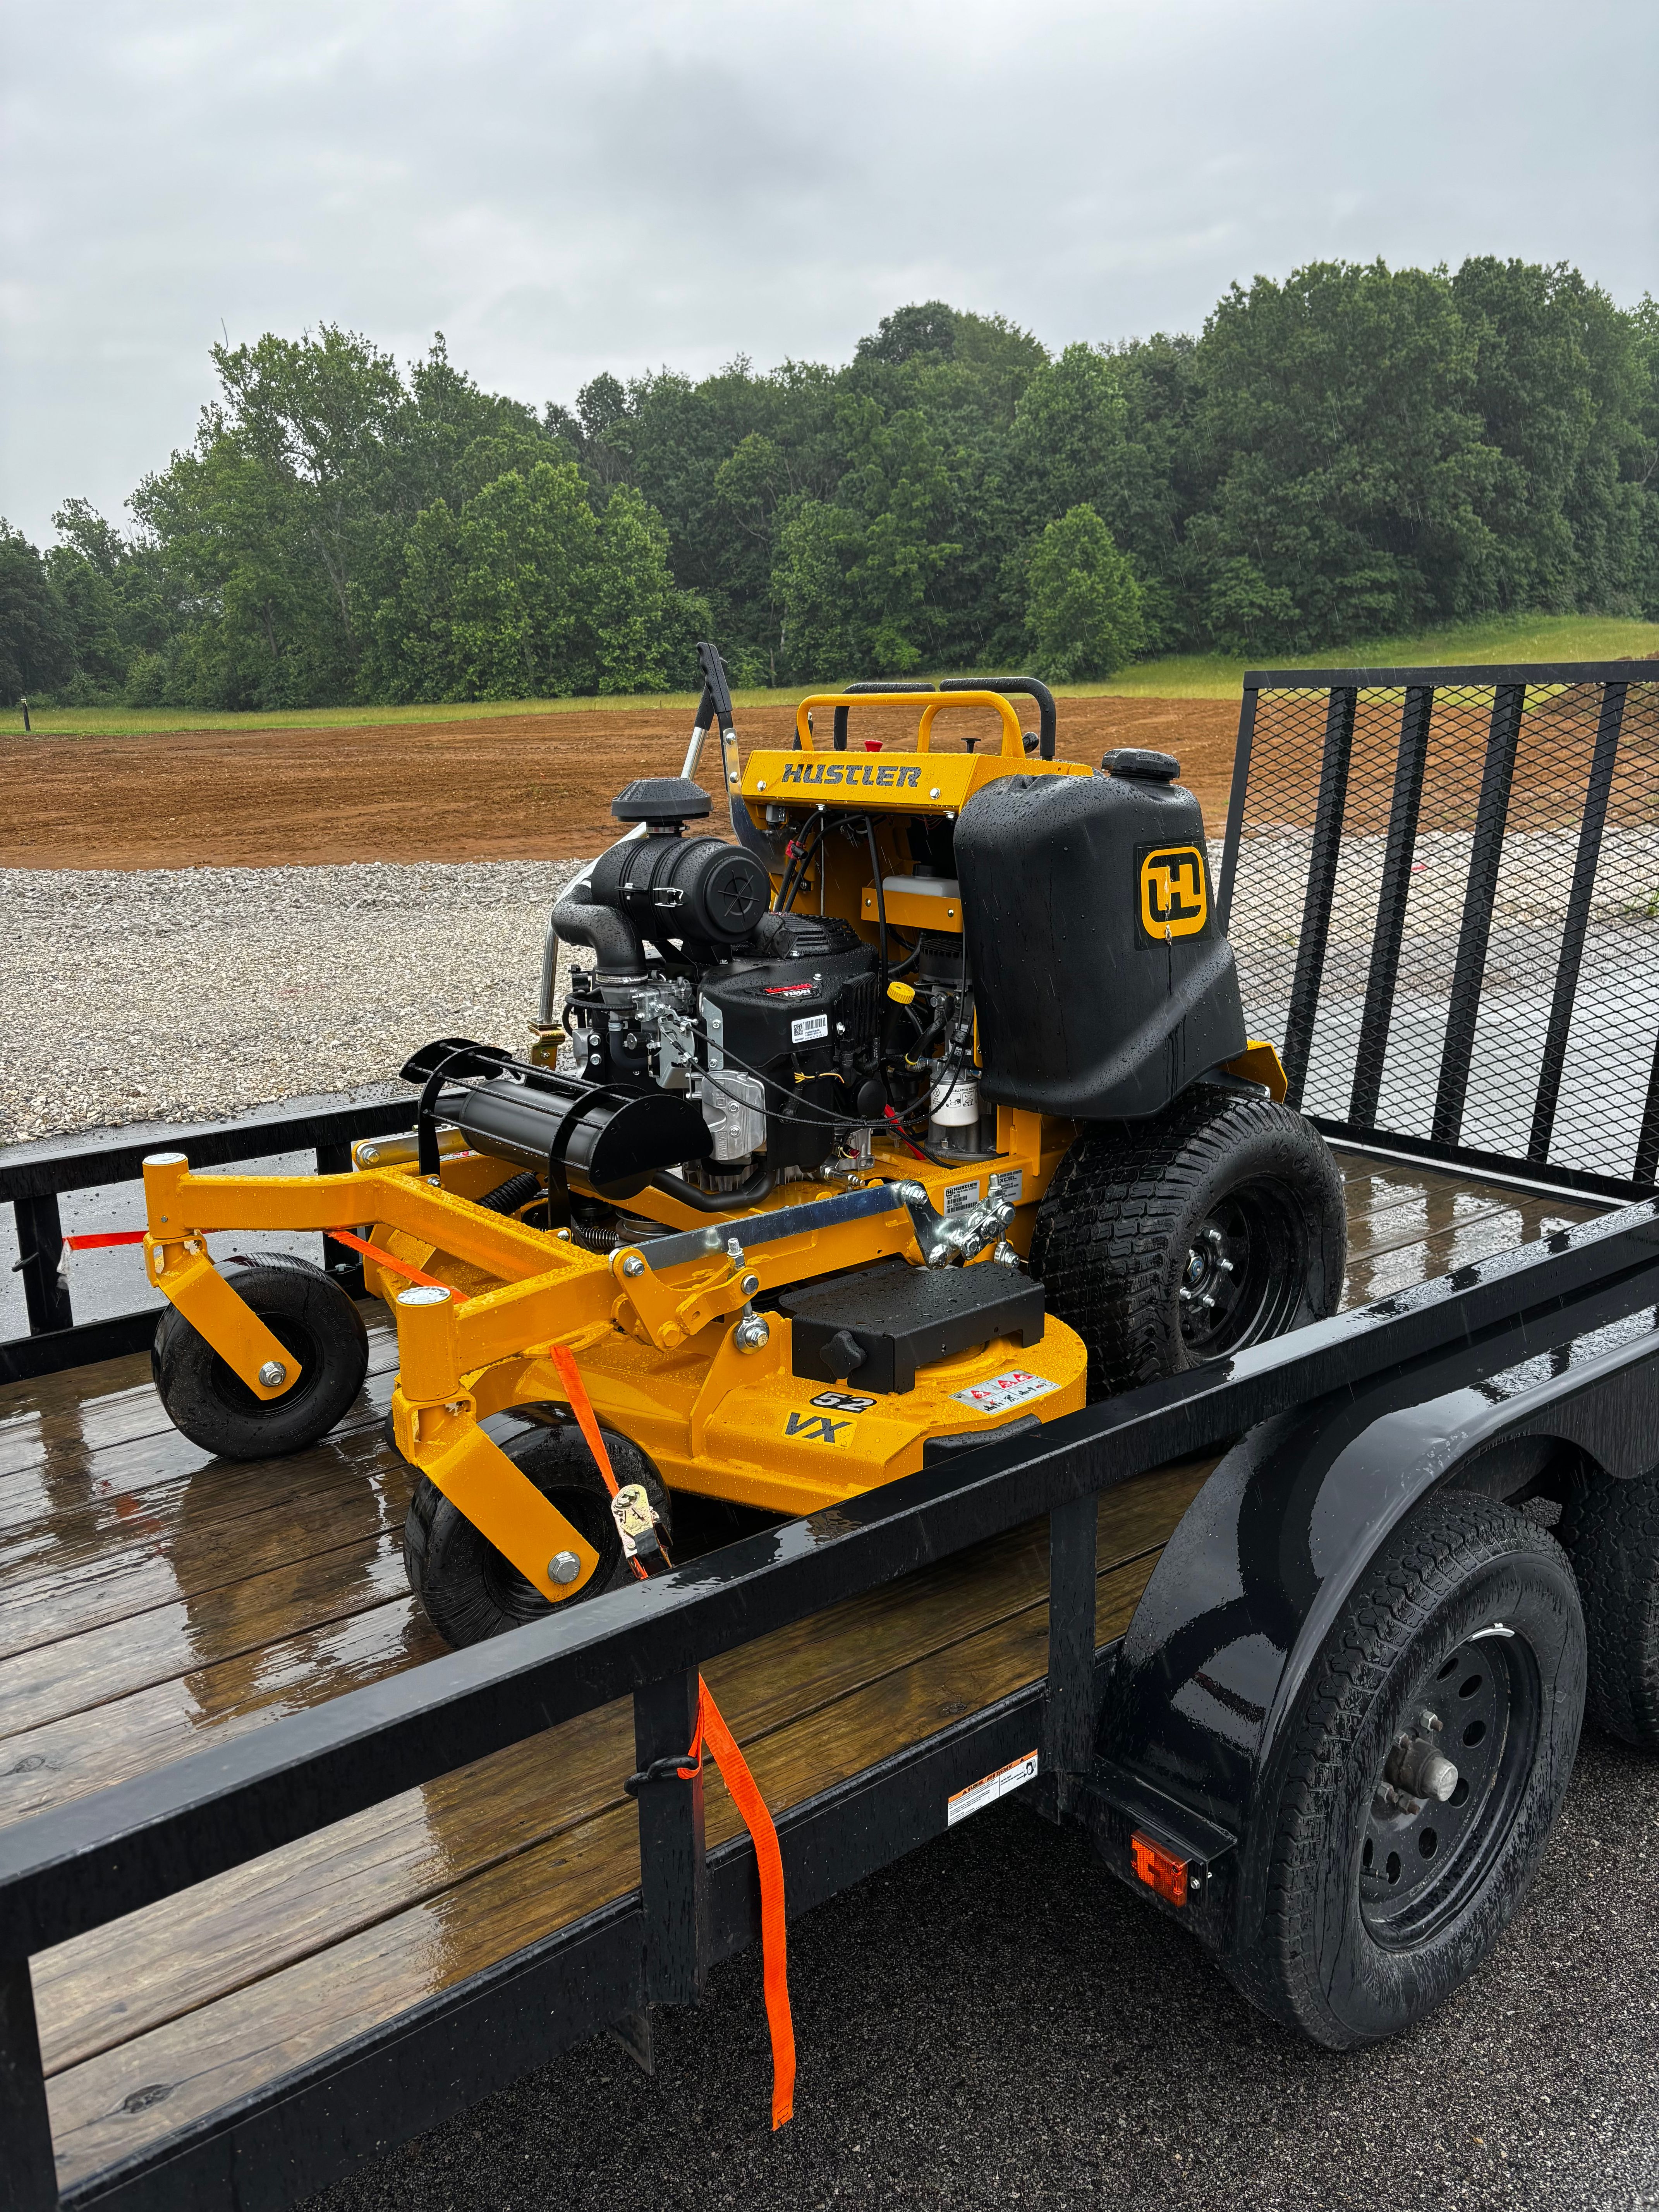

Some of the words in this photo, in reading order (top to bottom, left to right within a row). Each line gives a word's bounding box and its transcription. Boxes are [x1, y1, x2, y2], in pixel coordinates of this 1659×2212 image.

[781, 764, 922, 788] HUSTLER
[953, 1182, 977, 1191] HUSTLER
[811, 1391, 876, 1412] 52
[785, 1412, 854, 1444] VX
[967, 1780, 984, 1792] WARNING
[987, 1764, 1013, 1781] AVERTISSEMENT
